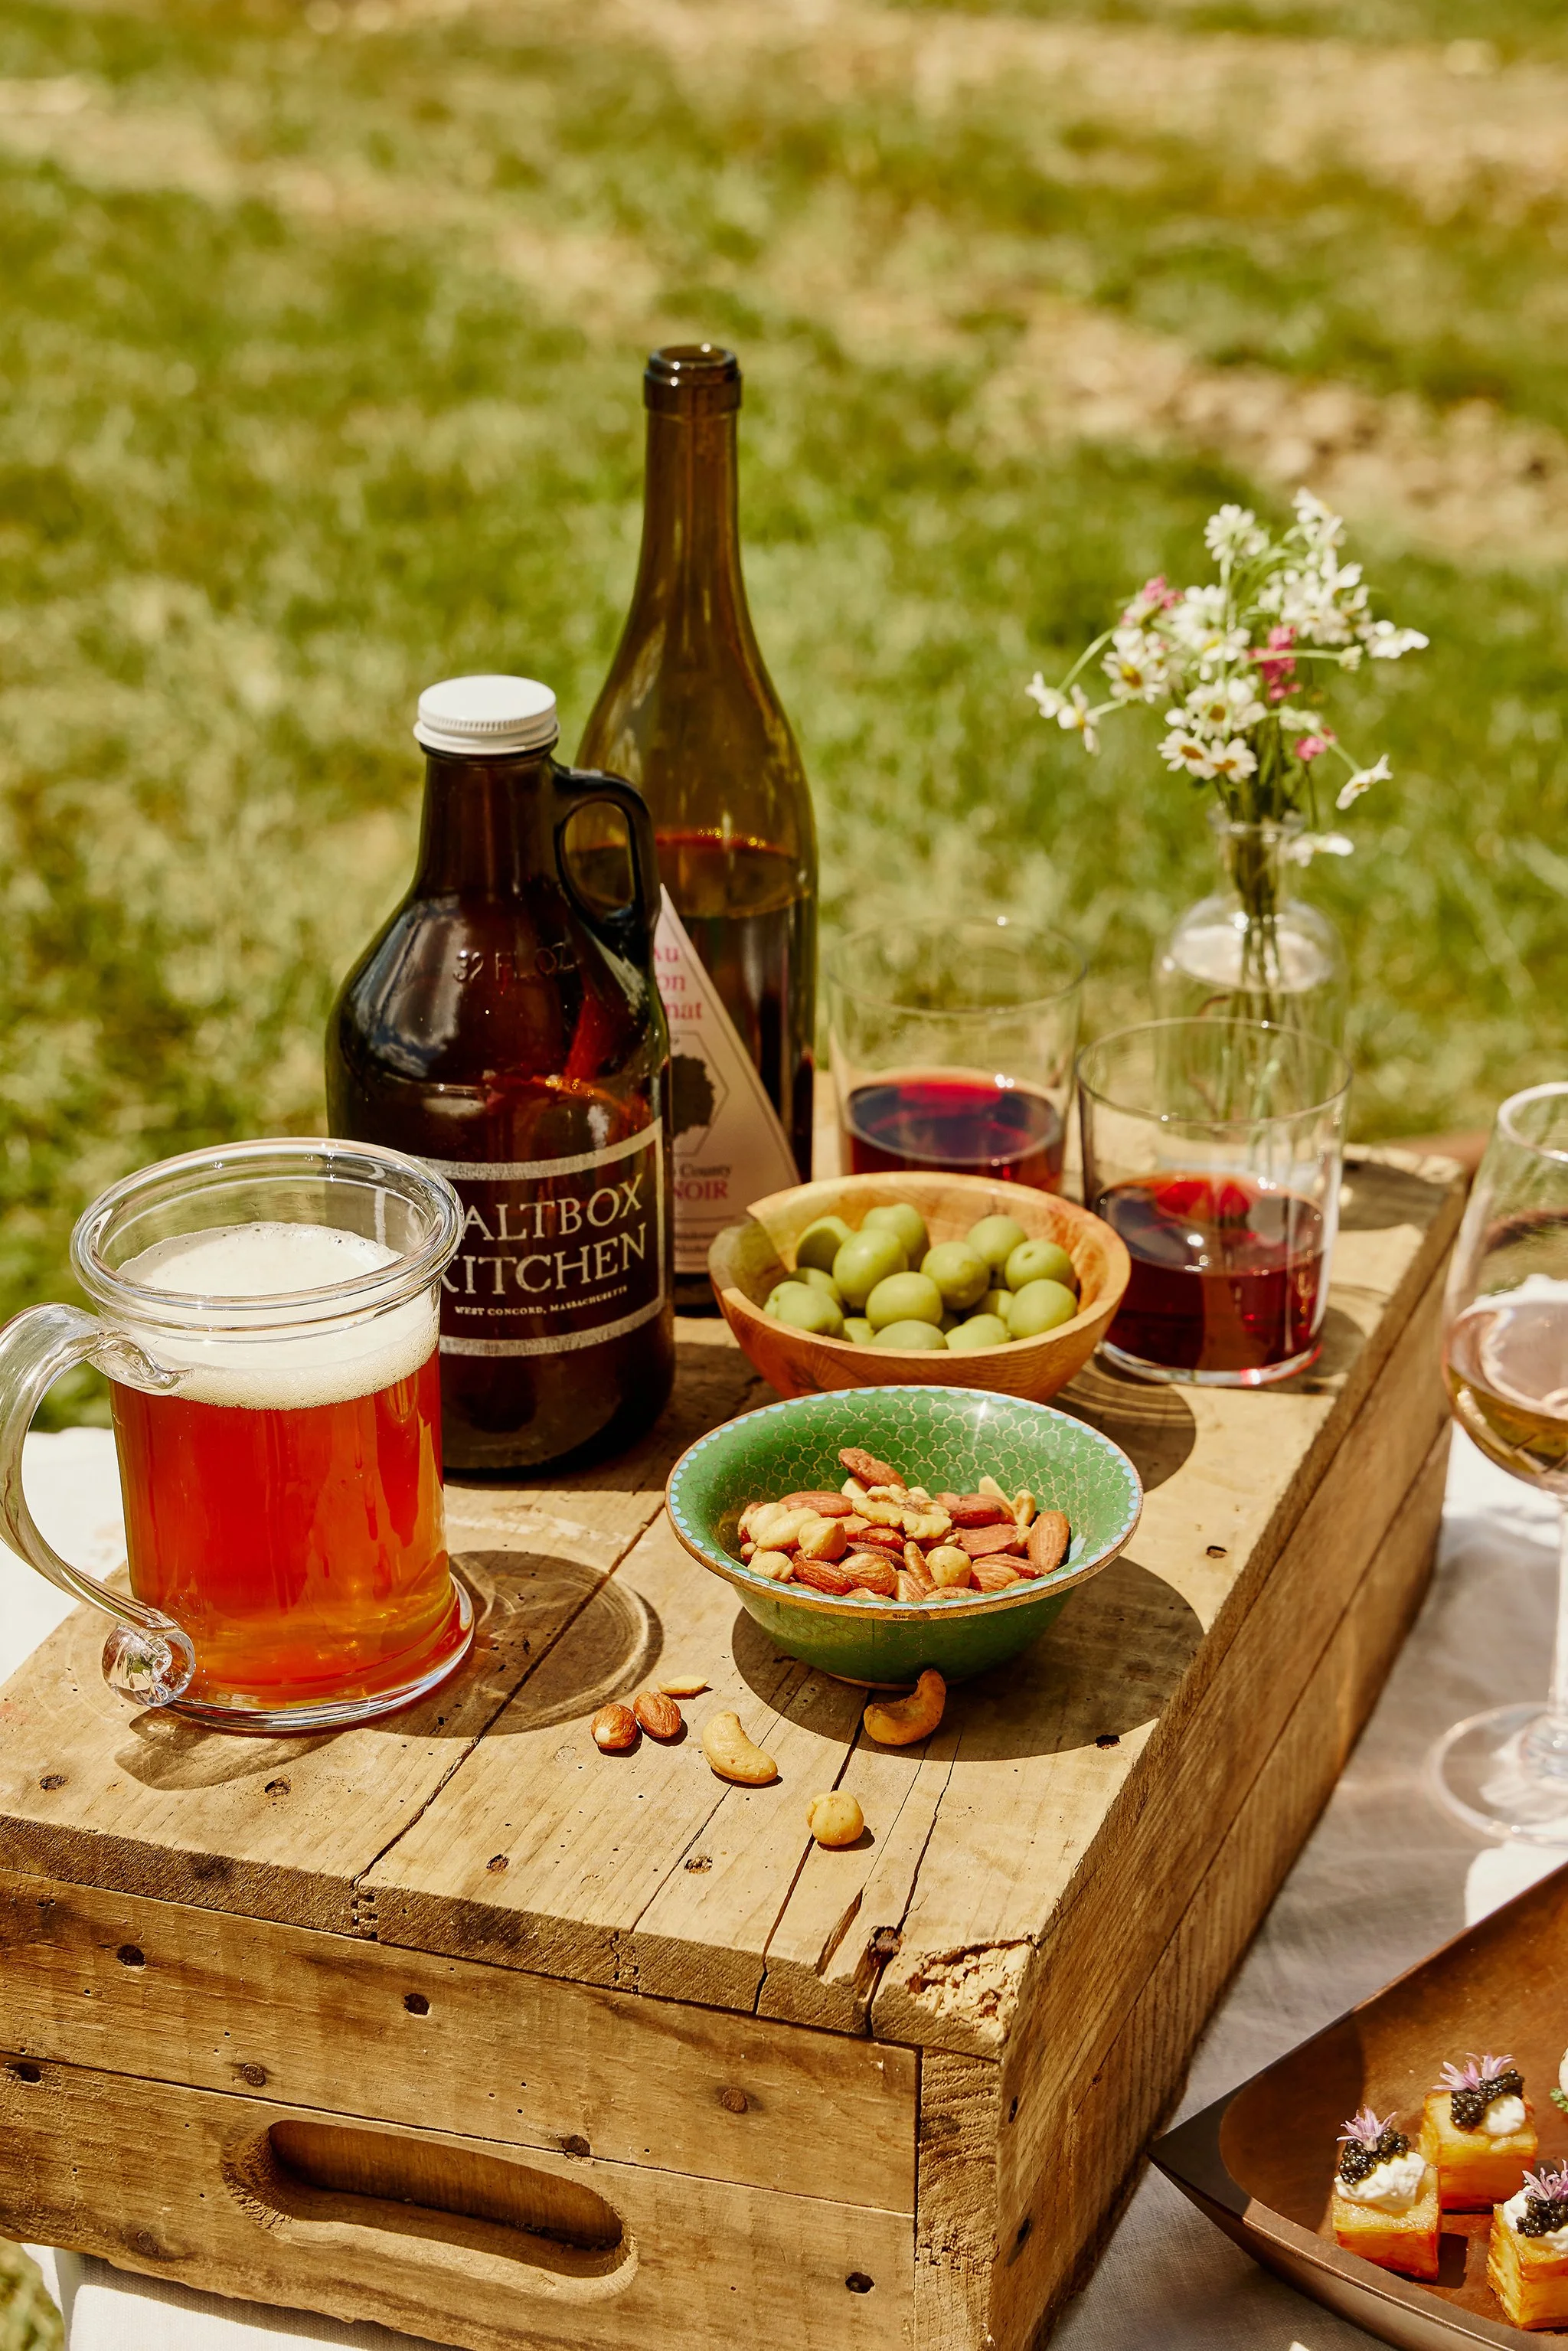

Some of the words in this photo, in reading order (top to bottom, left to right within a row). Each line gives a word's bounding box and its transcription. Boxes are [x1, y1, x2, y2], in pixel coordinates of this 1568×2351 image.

[453, 950, 484, 983] 32
[461, 1172, 642, 1241] ALTBOX
[454, 1306, 485, 1316] WEST
[487, 1306, 547, 1316] CONCORD,
[550, 1285, 628, 1313] MASSACHUSETTS
